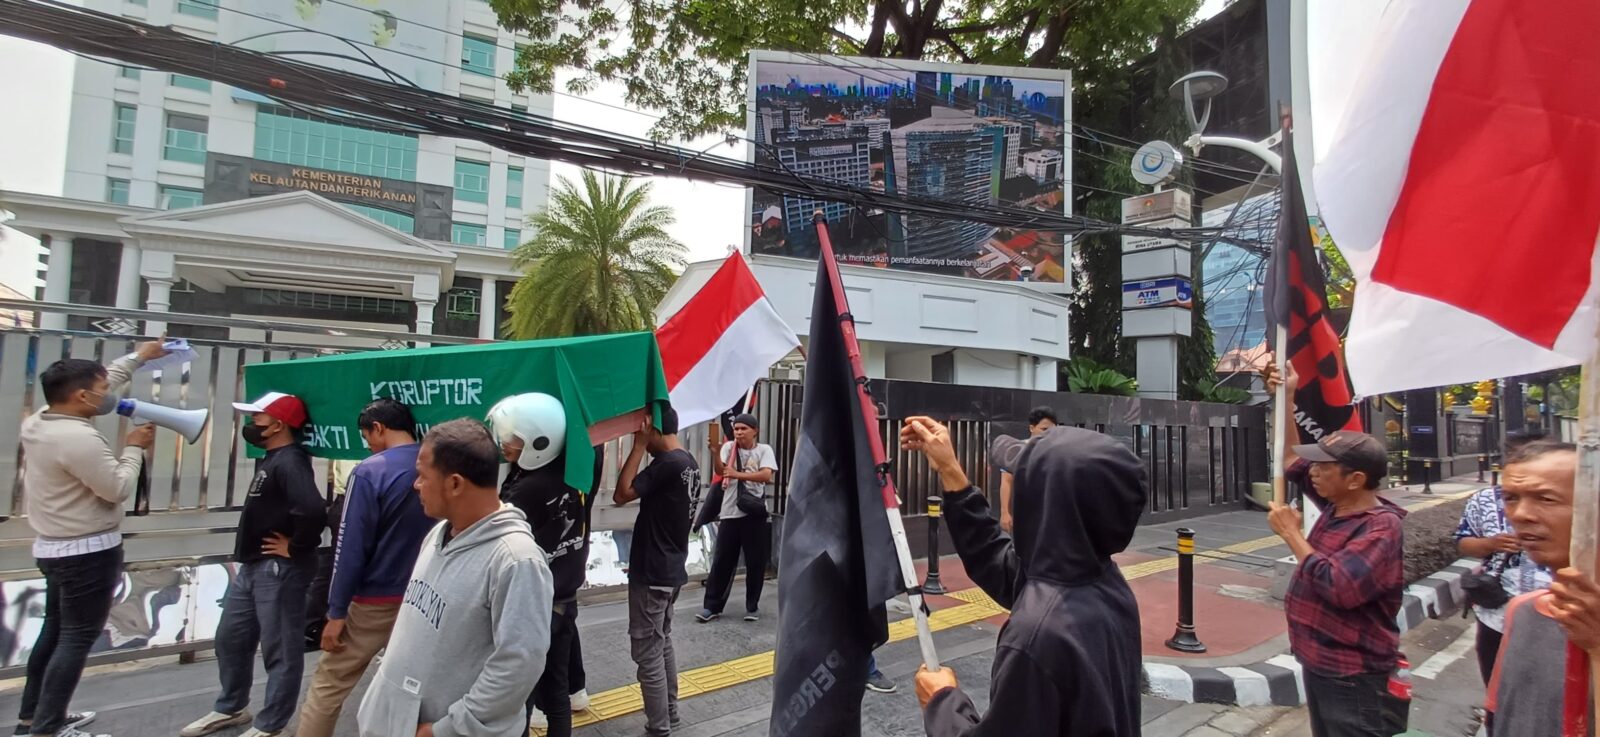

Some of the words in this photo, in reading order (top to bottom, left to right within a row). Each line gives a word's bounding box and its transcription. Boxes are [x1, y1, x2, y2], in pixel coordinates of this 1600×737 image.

[292, 168, 382, 188] KEMENTERIAN
[849, 254, 889, 263] memastikan
[890, 256, 945, 266] pemanfaatannya
[946, 257, 992, 268] berkelanjutan
[1138, 290, 1159, 298] ATM
[370, 377, 483, 406] KORUPTOR
[302, 423, 350, 450] SAKTI
